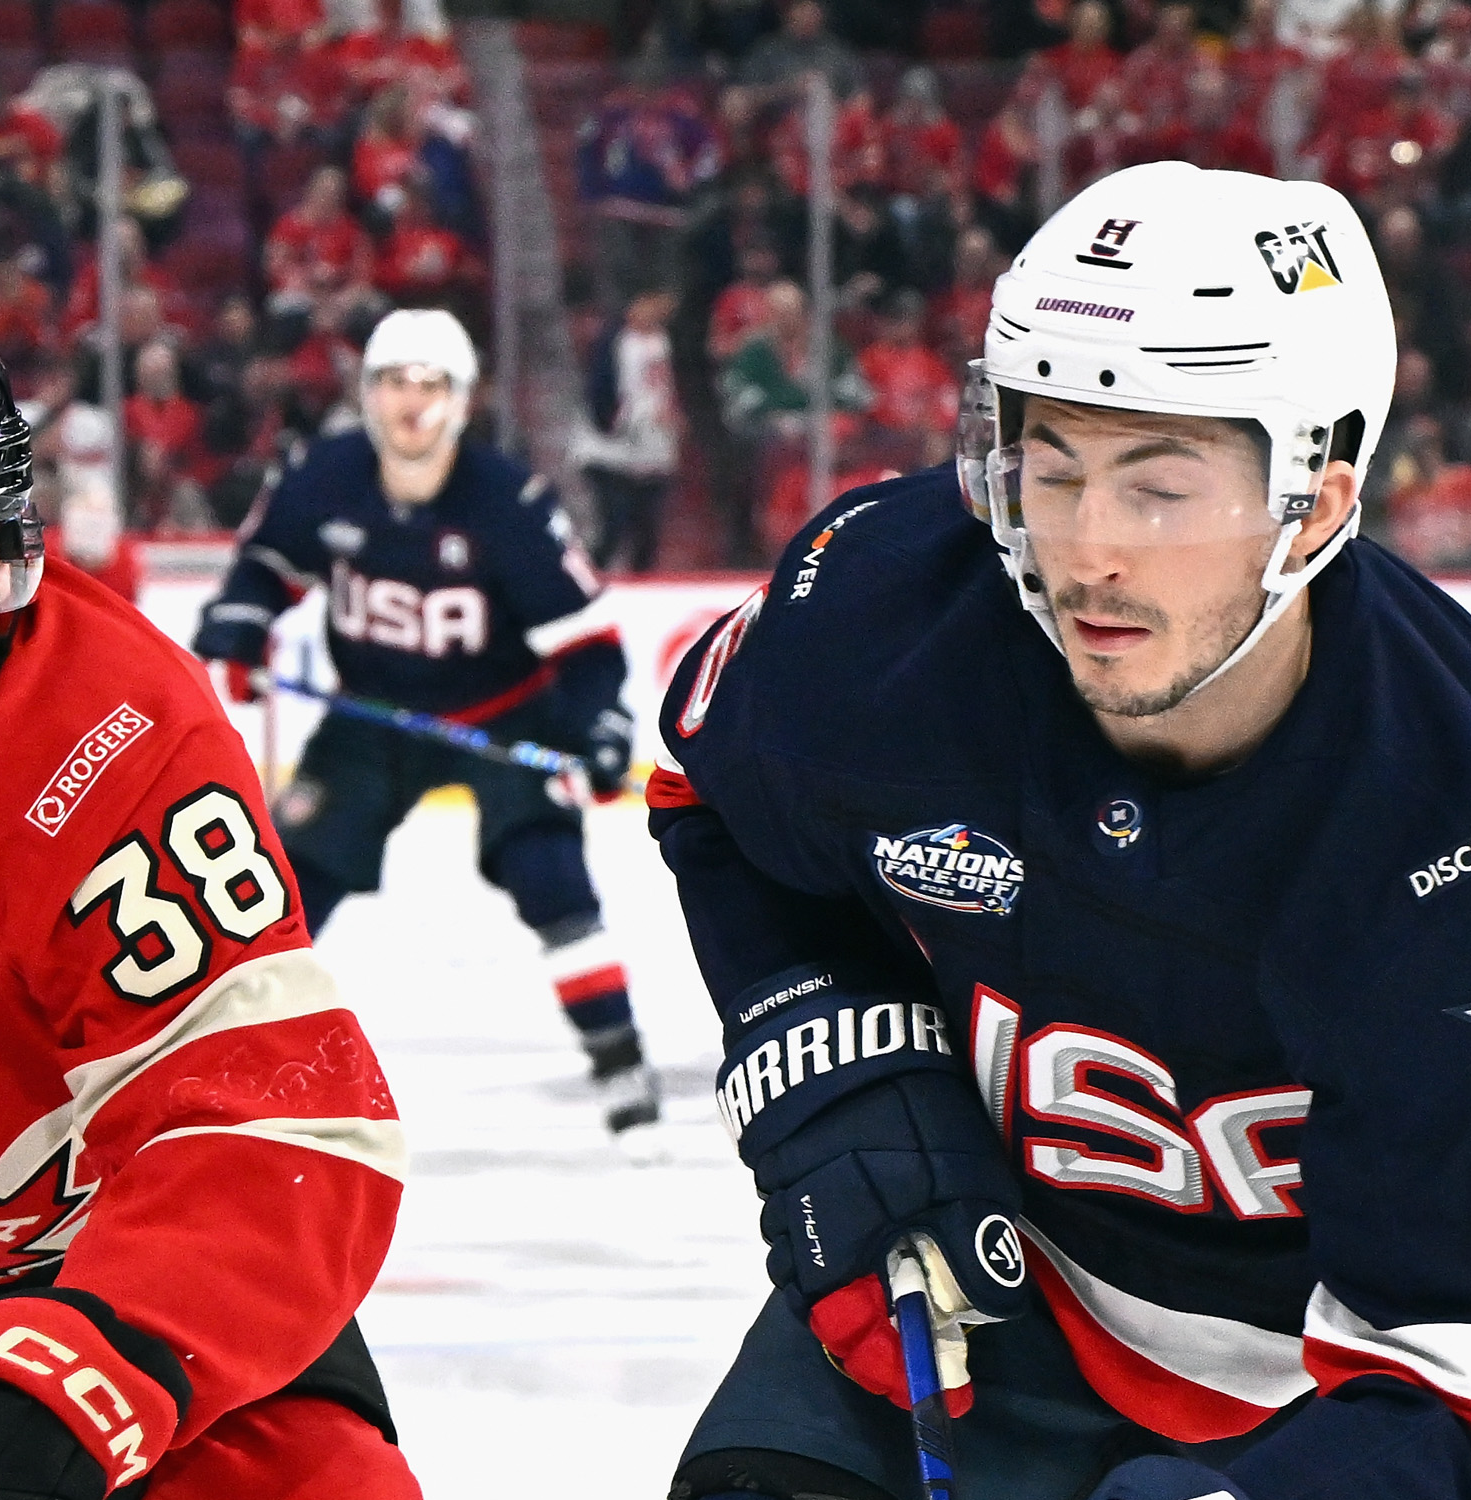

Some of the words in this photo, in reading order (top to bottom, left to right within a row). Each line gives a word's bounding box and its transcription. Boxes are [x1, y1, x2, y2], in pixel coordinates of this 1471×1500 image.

[1034, 297, 1135, 322] WARRIOR
[332, 558, 489, 658] USA
[56, 711, 143, 798] ROGERS
[873, 836, 1024, 882] NATIONS
[884, 859, 1013, 896] FACE-OFF
[67, 781, 290, 1007] 38
[739, 974, 833, 1024] WERENSKI
[800, 1194, 826, 1267] ALPHA
